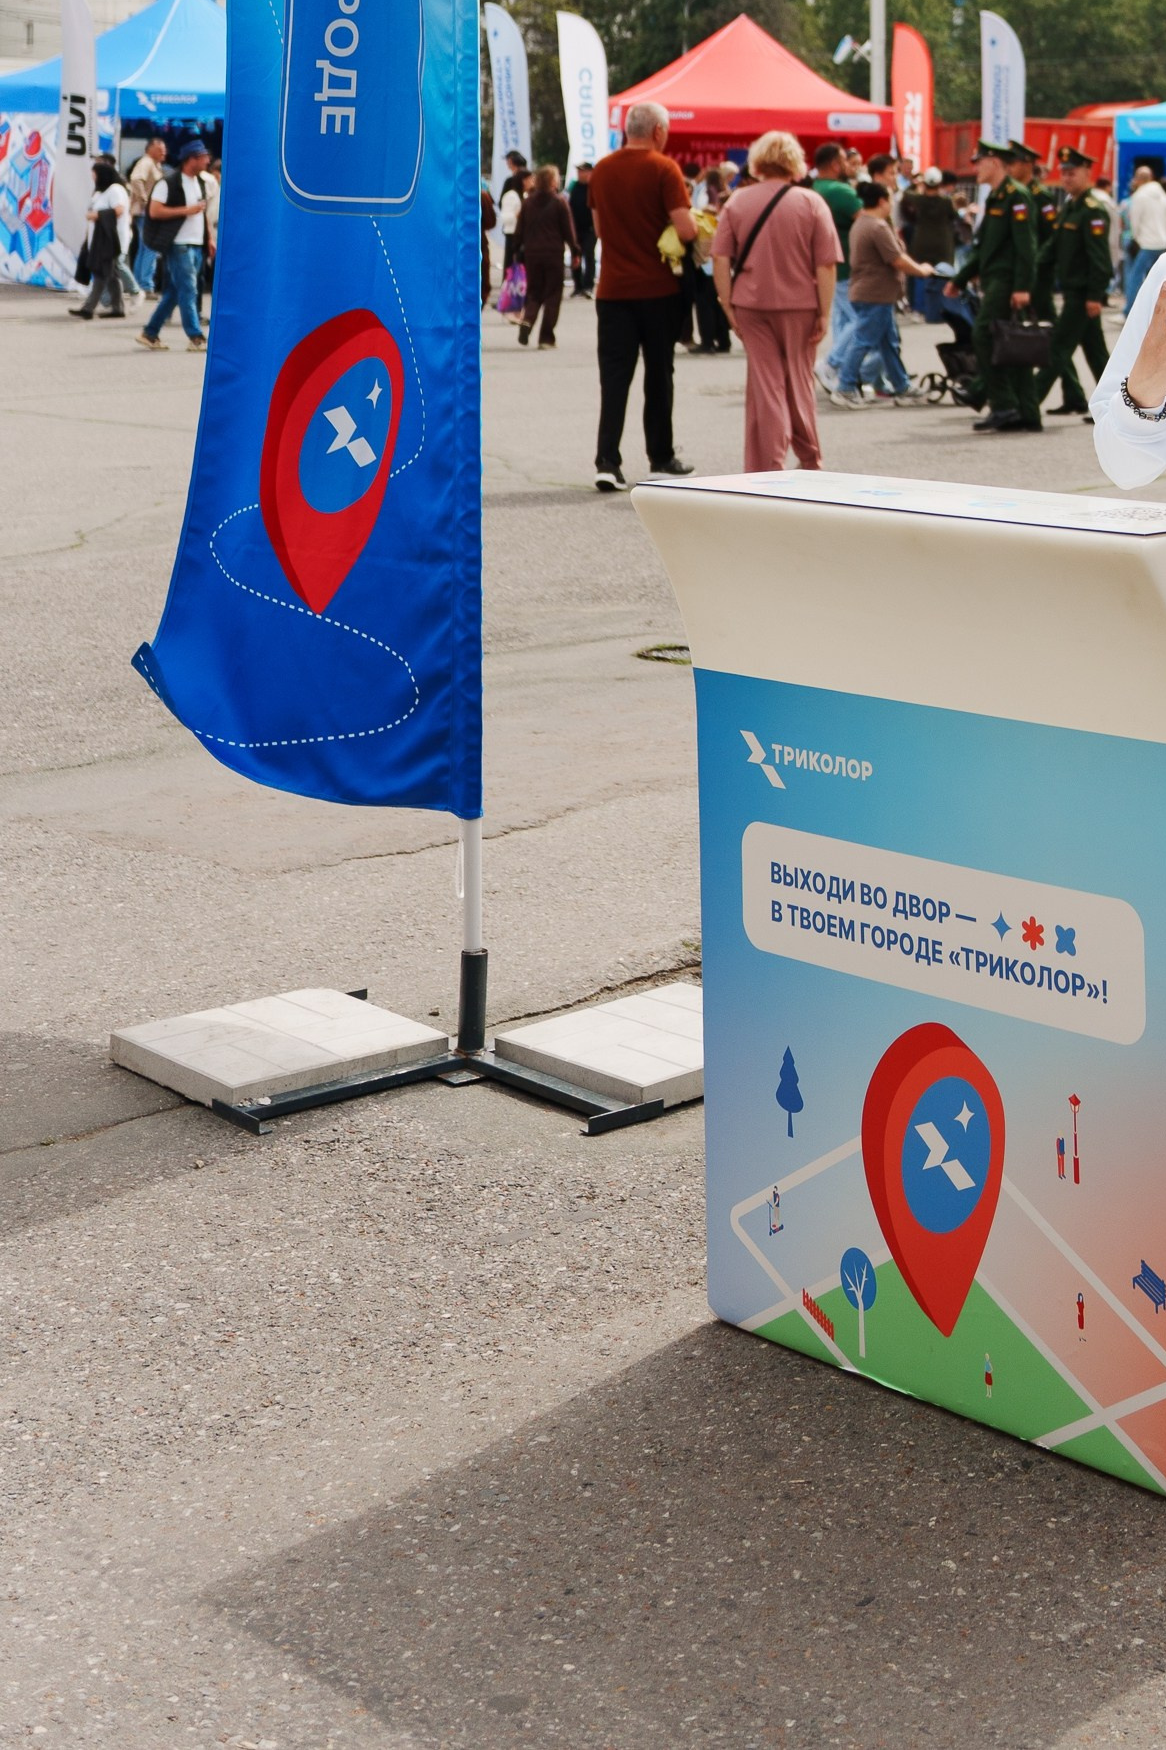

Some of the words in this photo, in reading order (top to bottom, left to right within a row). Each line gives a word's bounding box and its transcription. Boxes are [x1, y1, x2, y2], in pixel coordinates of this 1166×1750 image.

[771, 743, 873, 781] ТРИКОЛОР
[770, 861, 855, 903] ВЫХОДИ
[860, 883, 887, 910] ВО
[892, 891, 951, 924] ДВОР
[771, 900, 783, 923] В
[787, 903, 855, 942] ТВОЕМ
[860, 922, 943, 966] ГОРОДЕ
[949, 946, 1108, 1004] «ТРИКОЛОР»!
